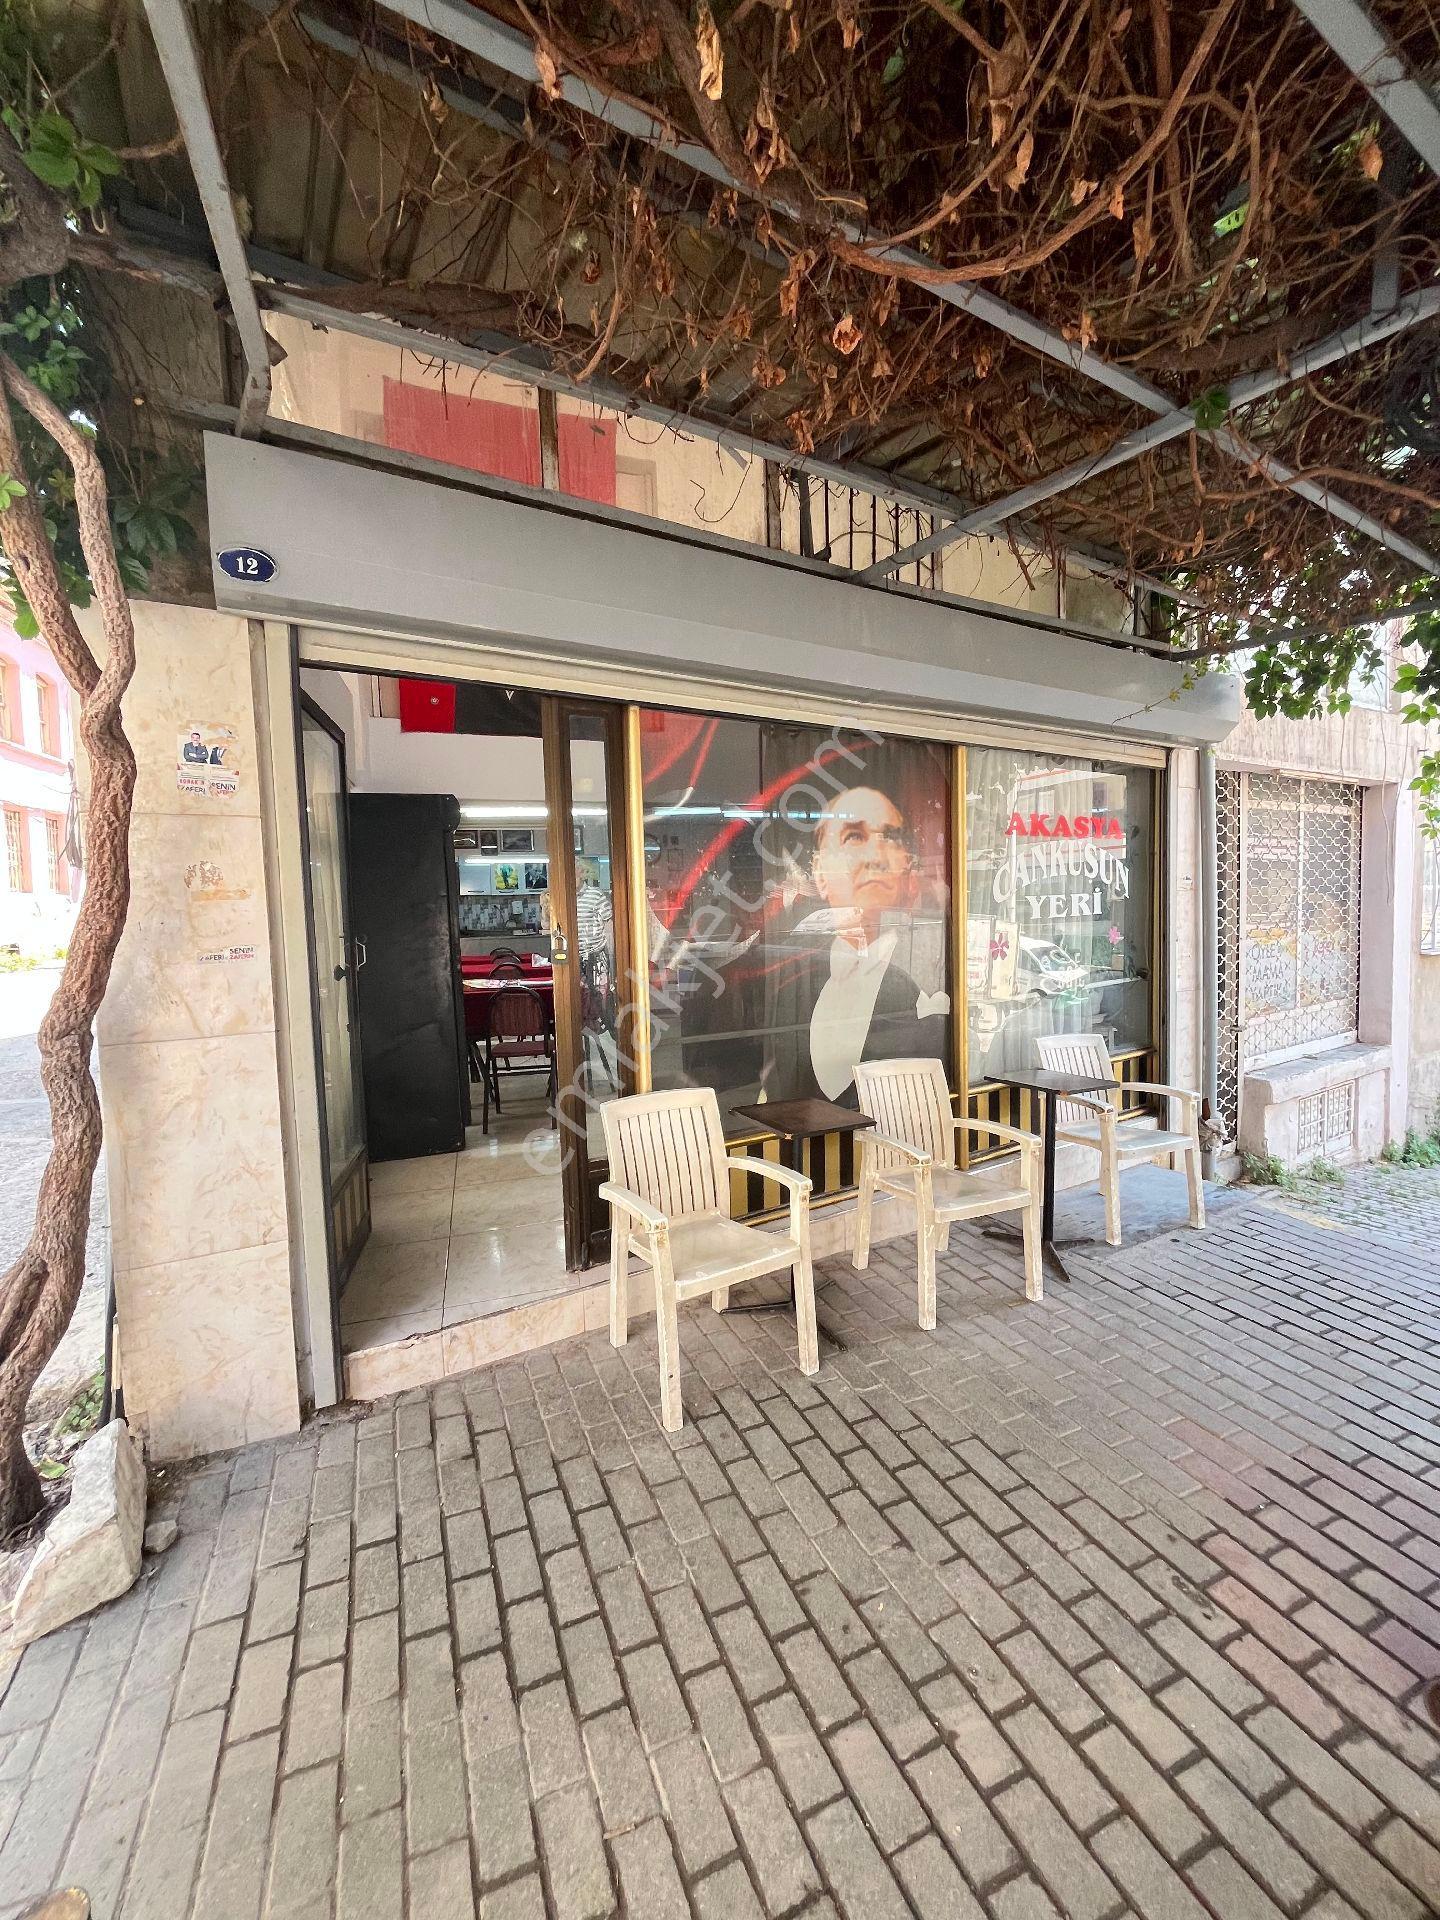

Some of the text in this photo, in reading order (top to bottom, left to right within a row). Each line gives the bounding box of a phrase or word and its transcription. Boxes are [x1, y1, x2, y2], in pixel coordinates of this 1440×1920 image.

[236, 556, 259, 575] 12
[1004, 812, 1124, 840] AKASYA
[1025, 887, 1103, 920] YERİ
